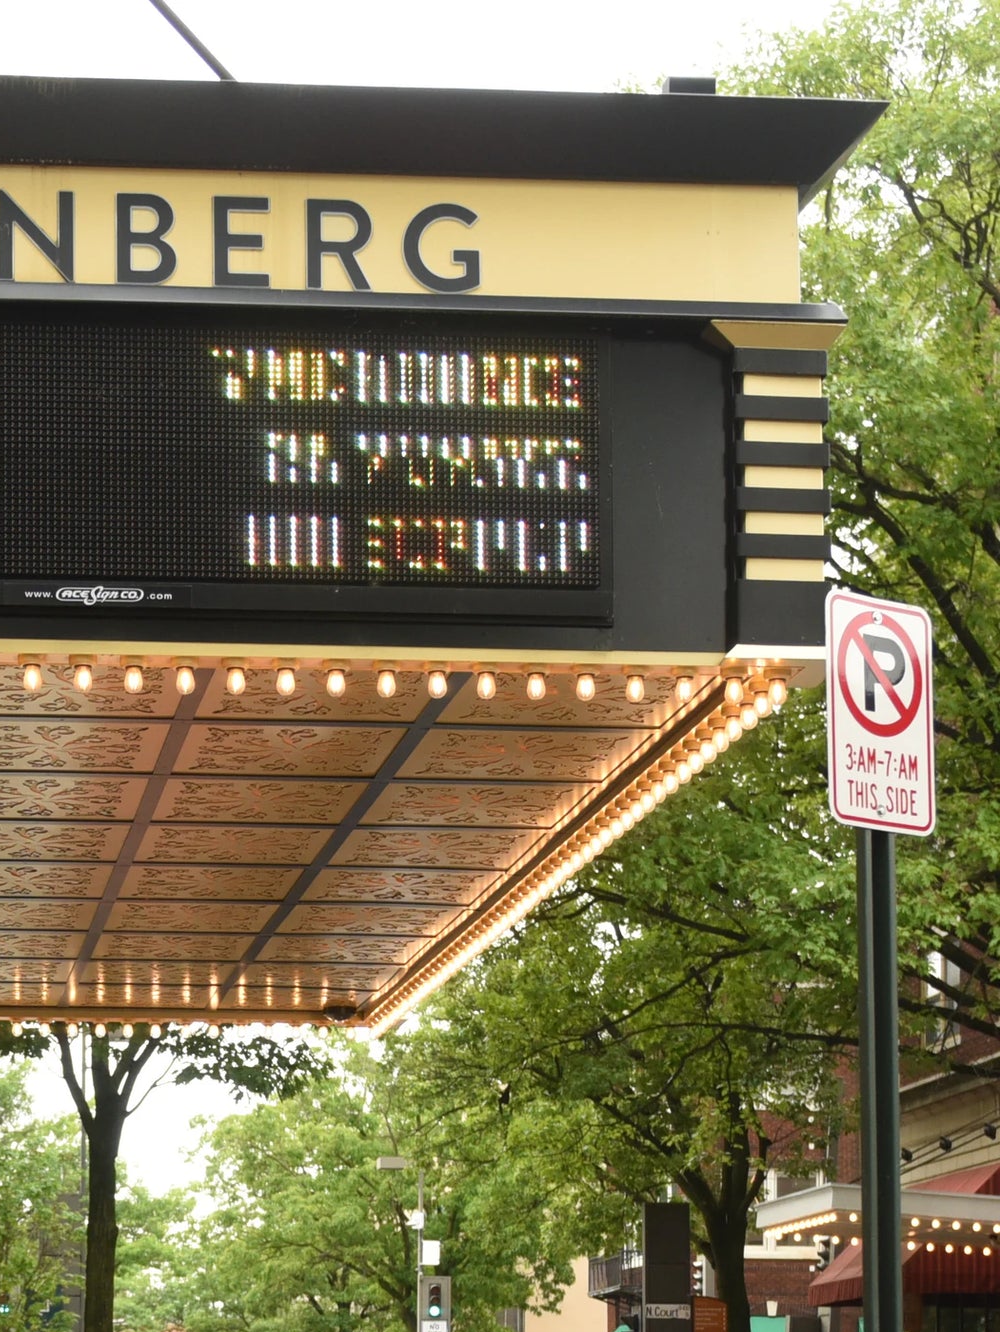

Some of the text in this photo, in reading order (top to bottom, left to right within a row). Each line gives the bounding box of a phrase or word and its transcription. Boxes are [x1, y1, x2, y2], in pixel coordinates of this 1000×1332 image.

[847, 779, 918, 817] THIS SIDE
[654, 1306, 679, 1318] Court
